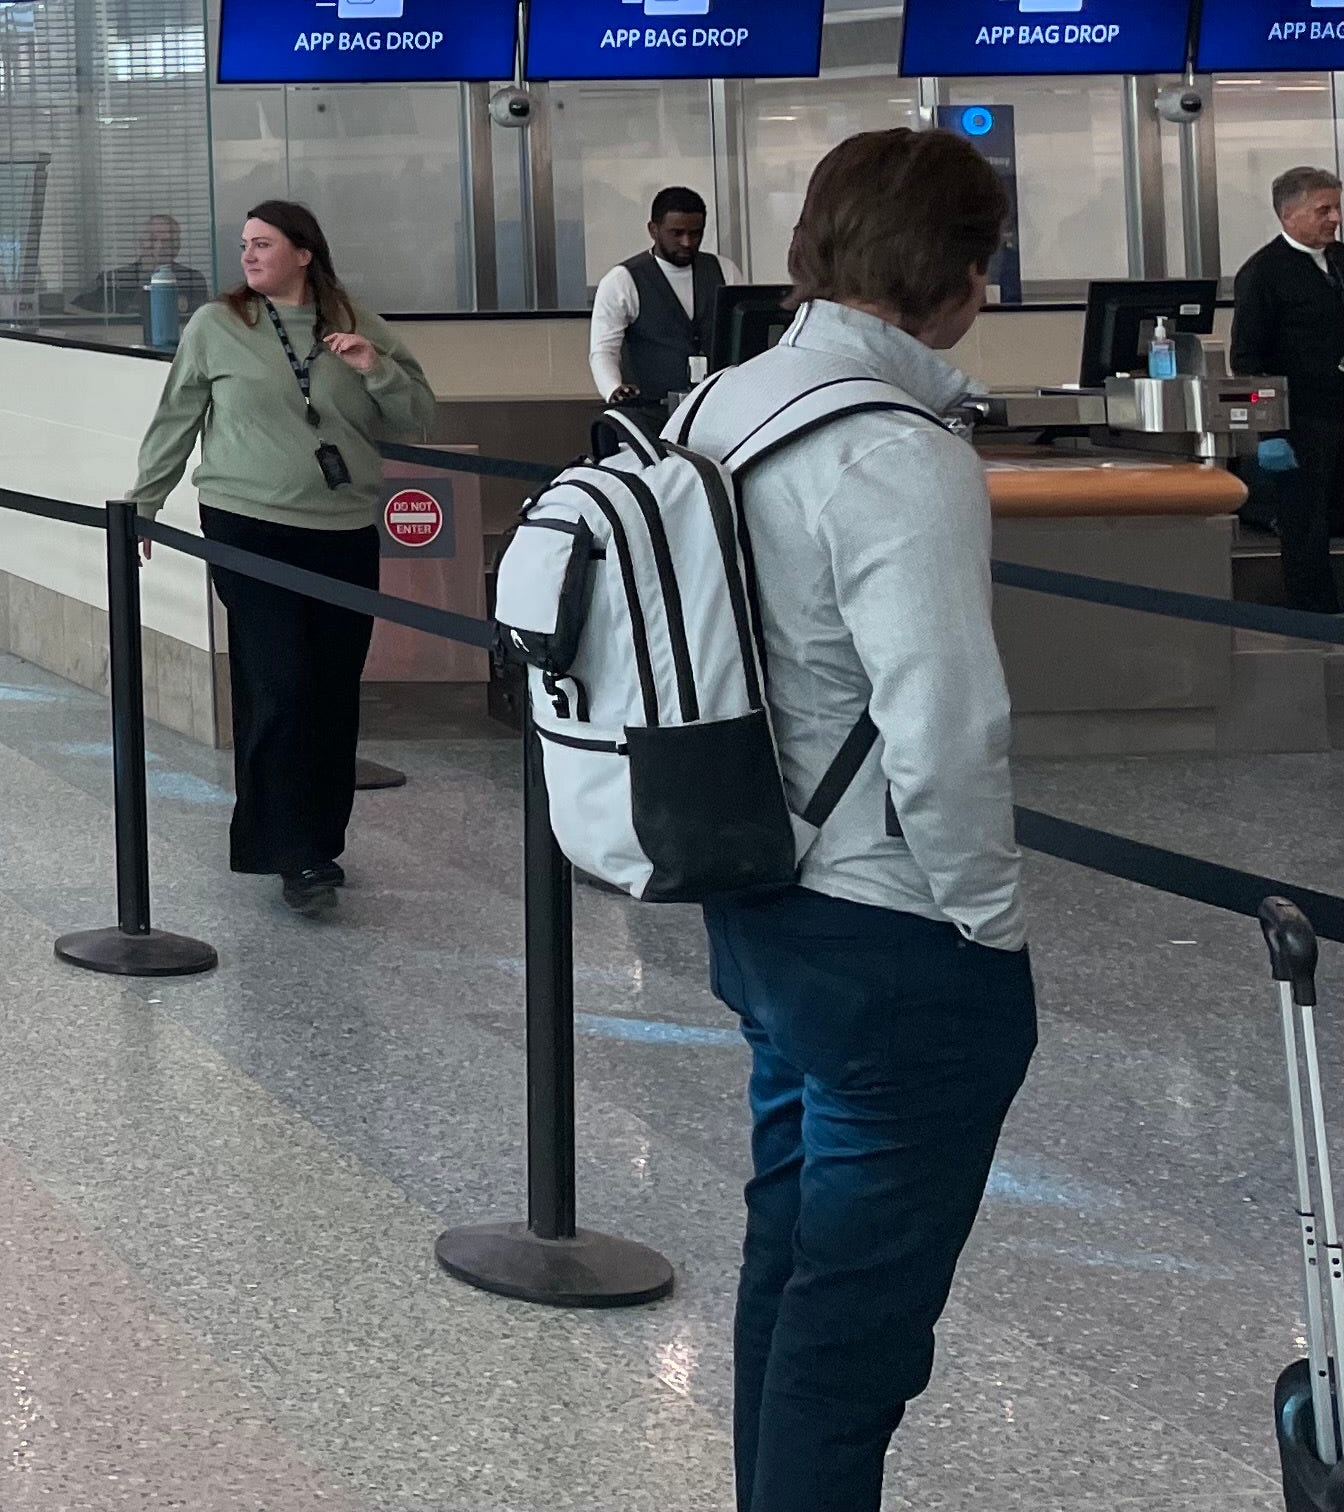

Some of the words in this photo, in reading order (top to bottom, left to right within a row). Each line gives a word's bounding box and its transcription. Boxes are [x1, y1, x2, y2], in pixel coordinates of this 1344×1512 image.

[295, 32, 334, 51] APP
[339, 32, 382, 51] BAG
[386, 31, 443, 50] DROP
[601, 30, 640, 48] APP
[644, 29, 687, 48] BAG
[692, 27, 749, 47] DROP
[976, 26, 1015, 45] APP
[1019, 25, 1059, 44] BAG
[1064, 25, 1120, 44] DROP
[1268, 22, 1307, 41] APP
[394, 502, 408, 512] DO
[410, 501, 432, 512] NOT
[396, 524, 432, 534] ENTER
